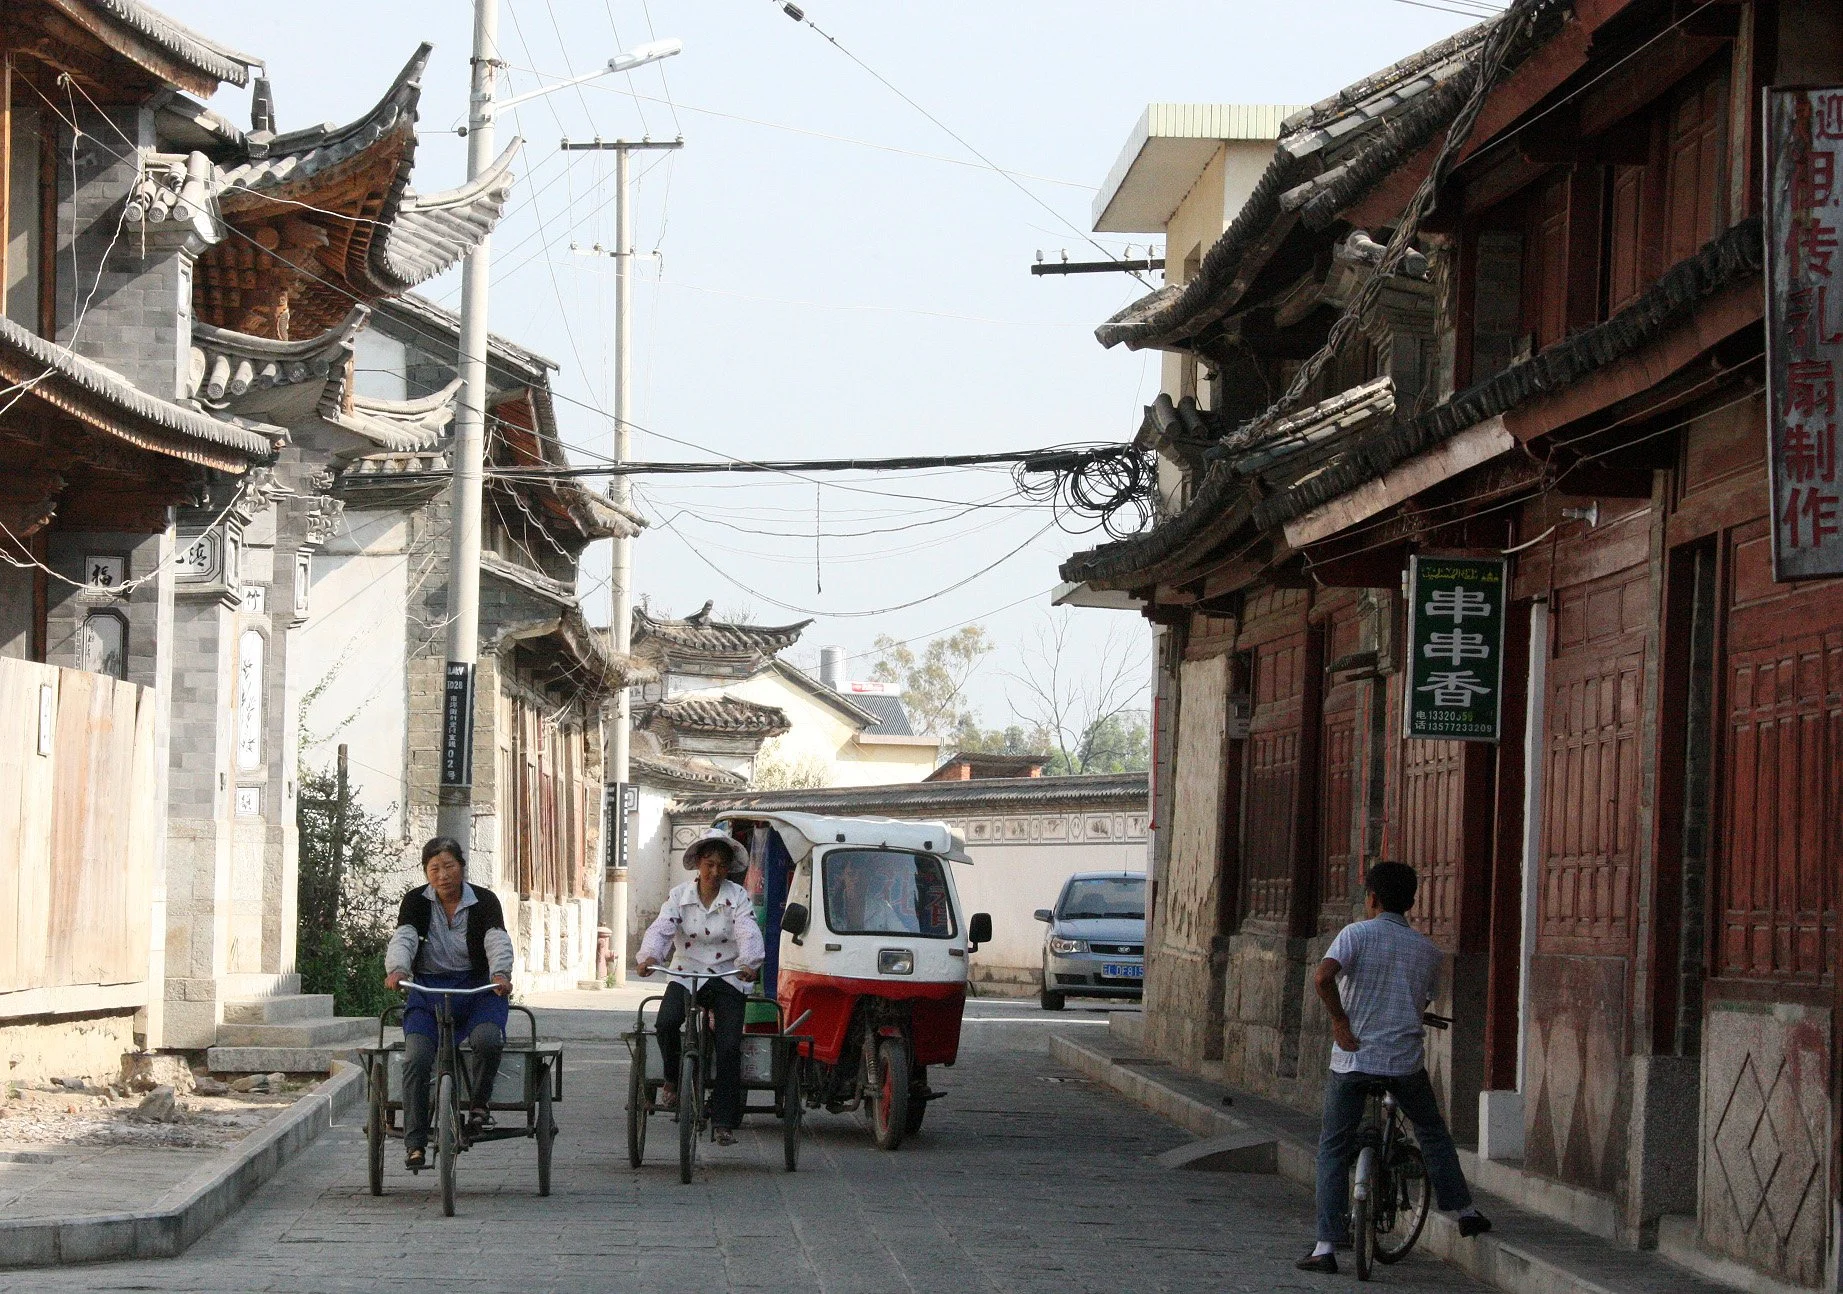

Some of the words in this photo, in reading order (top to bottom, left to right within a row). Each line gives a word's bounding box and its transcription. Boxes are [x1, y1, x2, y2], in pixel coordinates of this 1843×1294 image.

[92, 564, 113, 587] 福
[1416, 585, 1493, 708] 串串香
[1428, 722, 1493, 732] 13577233209
